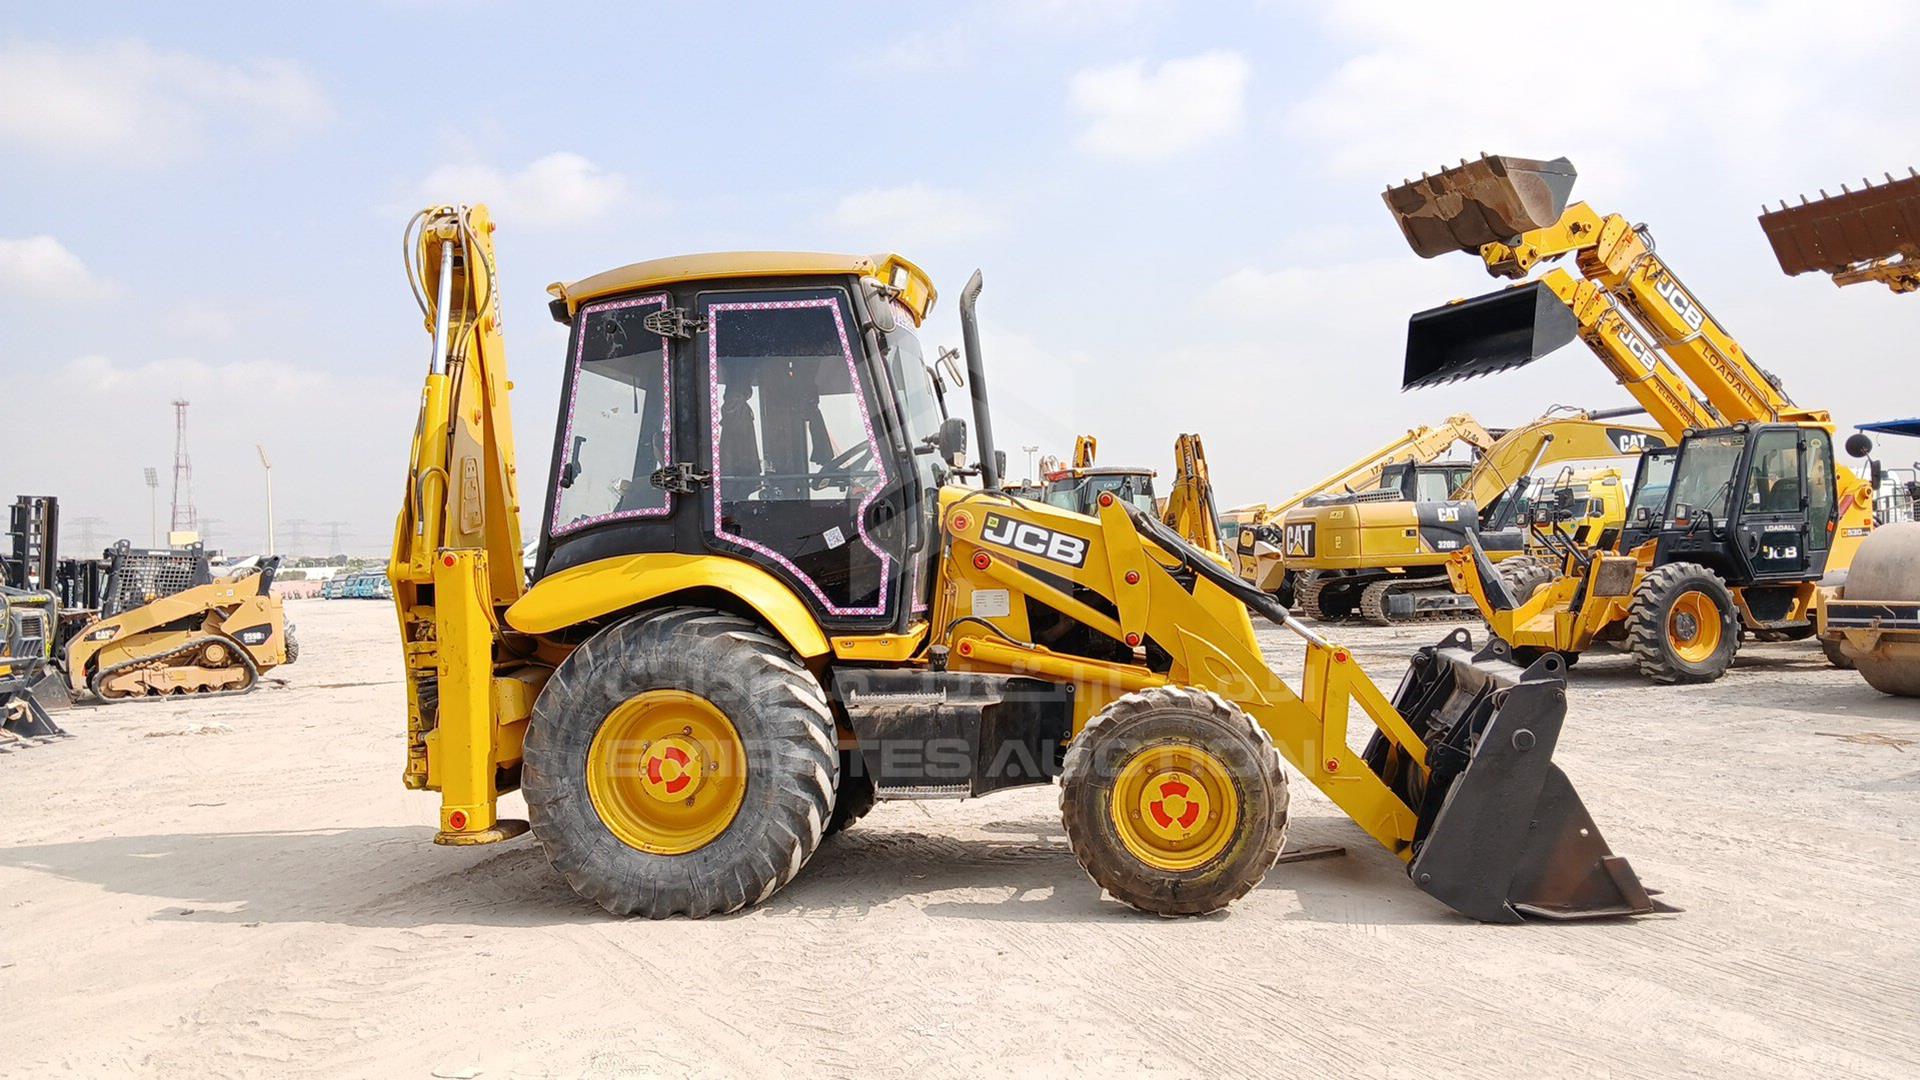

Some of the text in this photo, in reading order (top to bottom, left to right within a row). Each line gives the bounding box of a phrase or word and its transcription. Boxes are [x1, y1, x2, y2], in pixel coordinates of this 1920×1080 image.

[1656, 278, 1704, 331] JCB
[1618, 329, 1656, 371] JCB
[1702, 346, 1754, 407] LOADALL
[1620, 434, 1647, 453] CAT
[1437, 507, 1459, 522] CAT
[1286, 525, 1312, 556] CAT
[1764, 524, 1796, 532] LOADALL
[984, 520, 1085, 565] JCB
[1763, 546, 1798, 560] JCB
[95, 630, 110, 640] CAT
